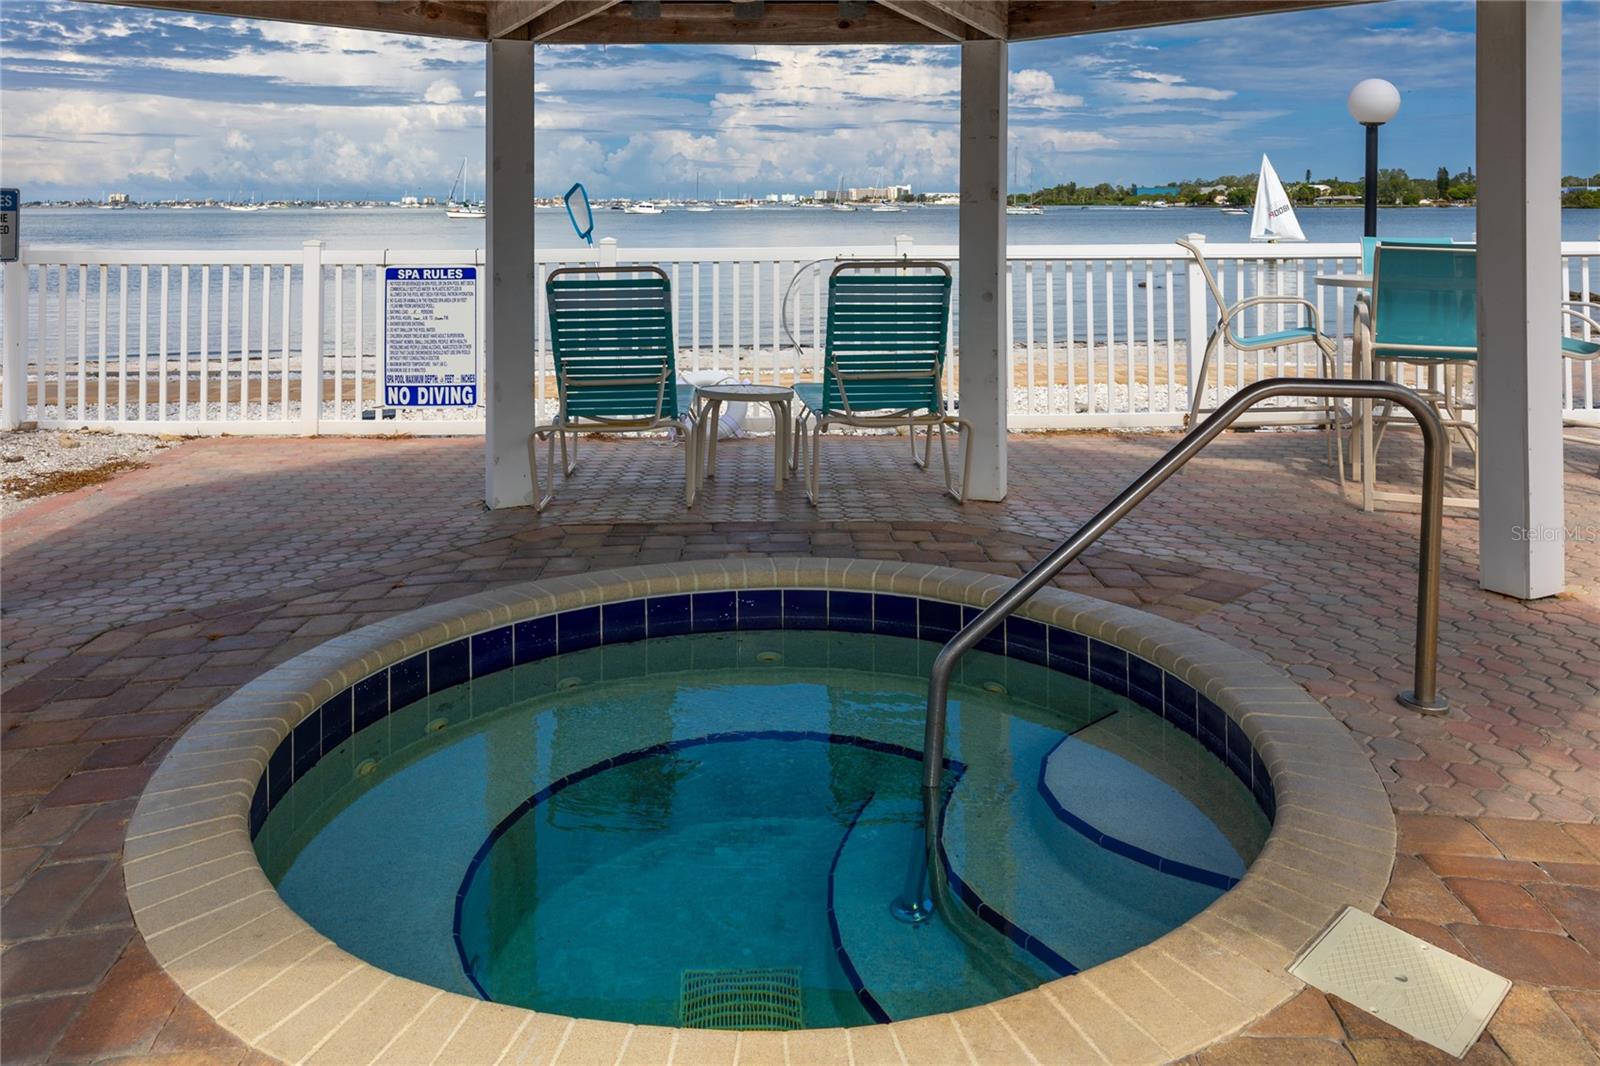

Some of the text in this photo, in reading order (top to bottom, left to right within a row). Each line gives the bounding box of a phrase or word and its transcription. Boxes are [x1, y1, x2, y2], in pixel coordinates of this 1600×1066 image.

[397, 269, 463, 279] SPA RULES
[395, 375, 405, 383] POOL
[445, 374, 454, 383] FEET
[388, 386, 473, 404] NO DIVING
